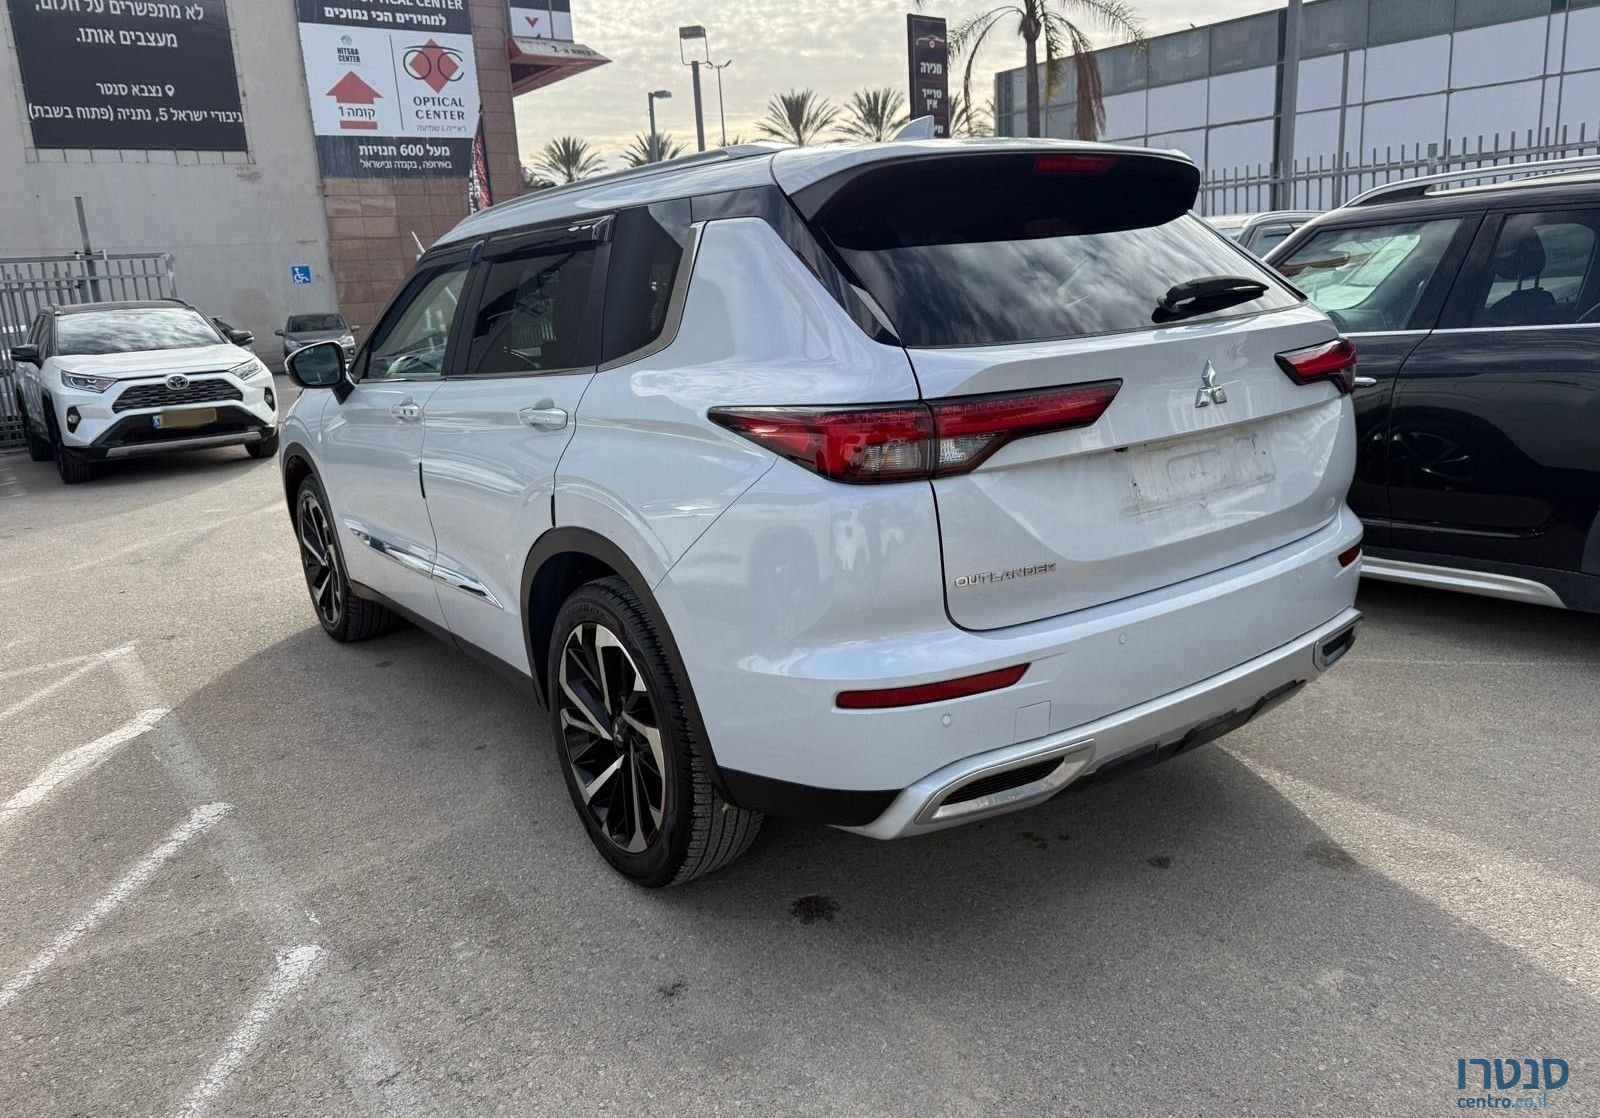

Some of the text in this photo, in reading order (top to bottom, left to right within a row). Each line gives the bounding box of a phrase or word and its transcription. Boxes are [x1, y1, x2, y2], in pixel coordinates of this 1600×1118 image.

[86, 0, 104, 12] על
[110, 0, 182, 18] מתפשרים
[186, 4, 204, 20] לא
[324, 6, 447, 26] למחירים הכי נמוכים
[76, 27, 178, 48] מעצבים אותו.
[96, 82, 162, 97] נצבא סנטר
[413, 96, 465, 108] OPTICAL
[29, 103, 243, 122] גיבורי ישראל 5, נתניה (פתוח בשבת)
[338, 106, 376, 119] קומה 1
[416, 109, 465, 120] CENTER
[358, 144, 450, 156] מעל 600 חנויות
[954, 562, 1056, 588] OUTLANDER
